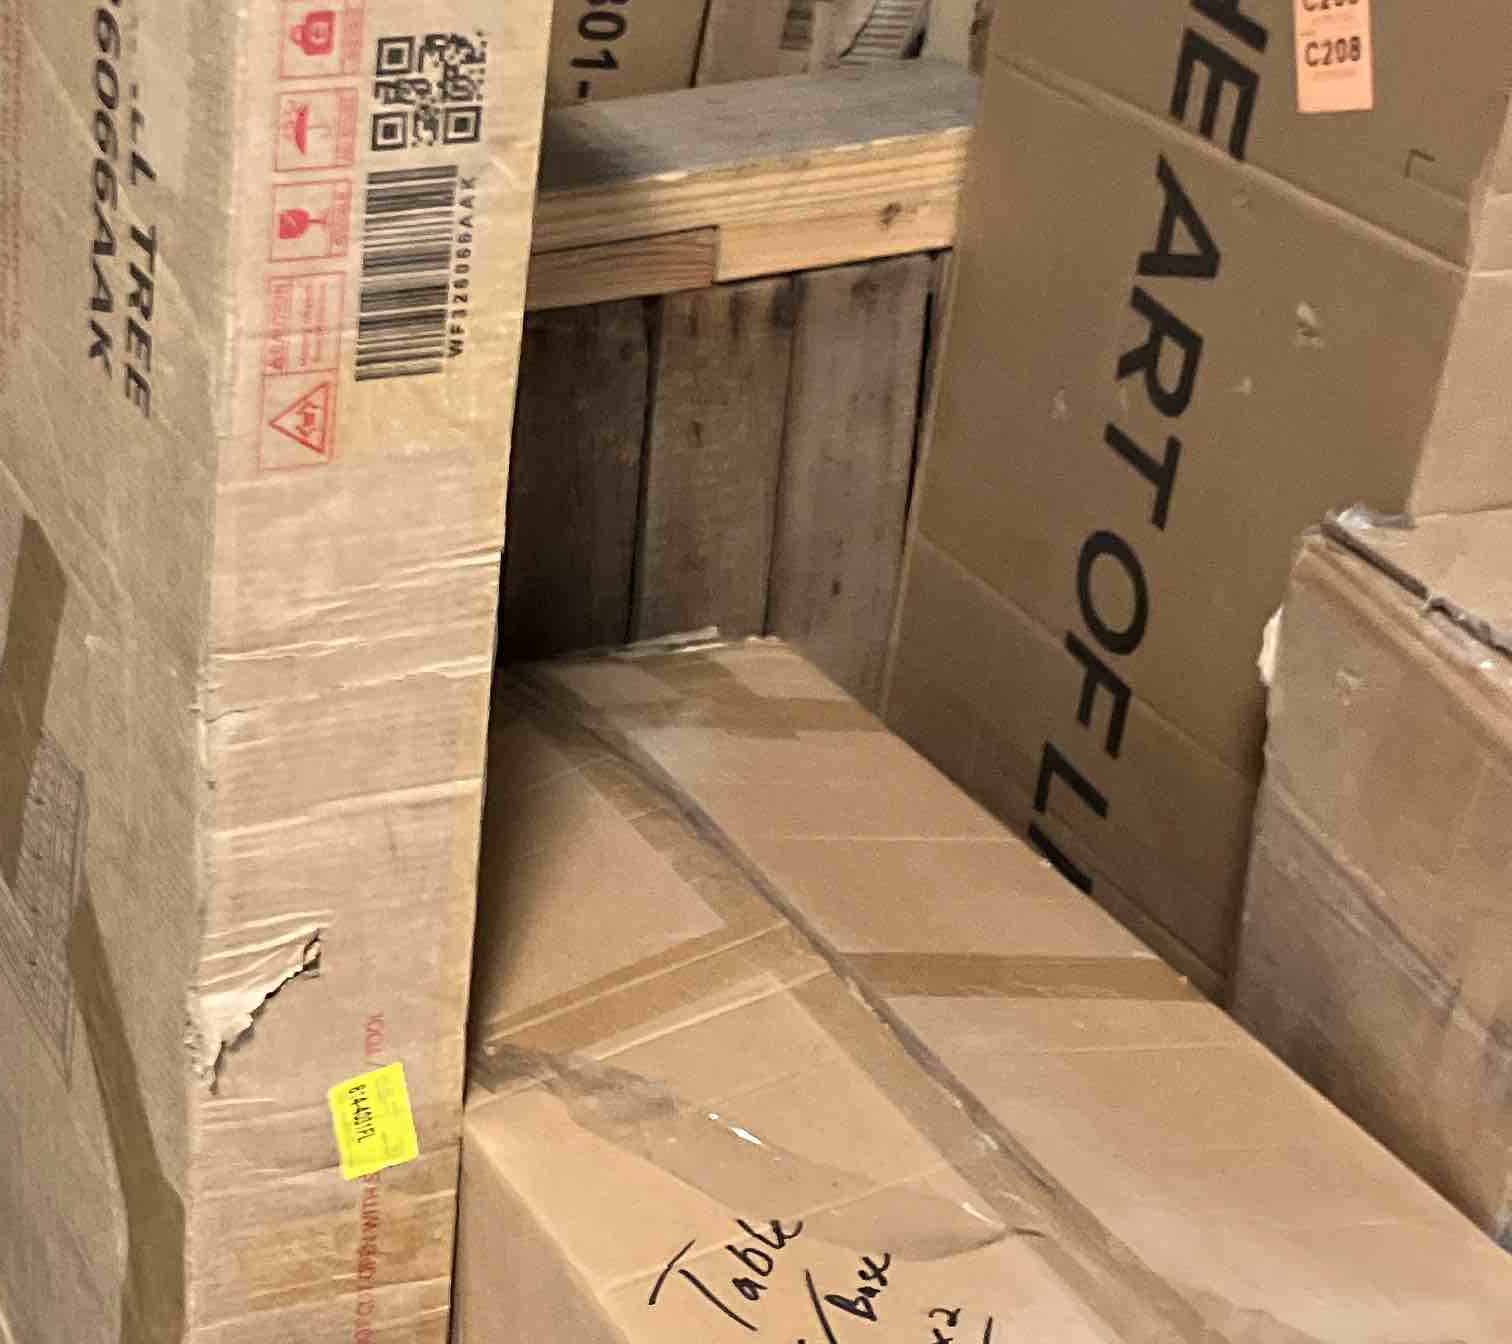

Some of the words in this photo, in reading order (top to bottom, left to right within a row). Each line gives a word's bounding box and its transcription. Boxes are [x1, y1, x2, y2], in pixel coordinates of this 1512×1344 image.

[1303, 35, 1362, 68] C208
[124, 224, 159, 420] TREE
[447, 176, 476, 358] WF326066AAK
[1102, 152, 1223, 531] ART
[1064, 528, 1151, 761] OF
[647, 1217, 804, 1333] Table
